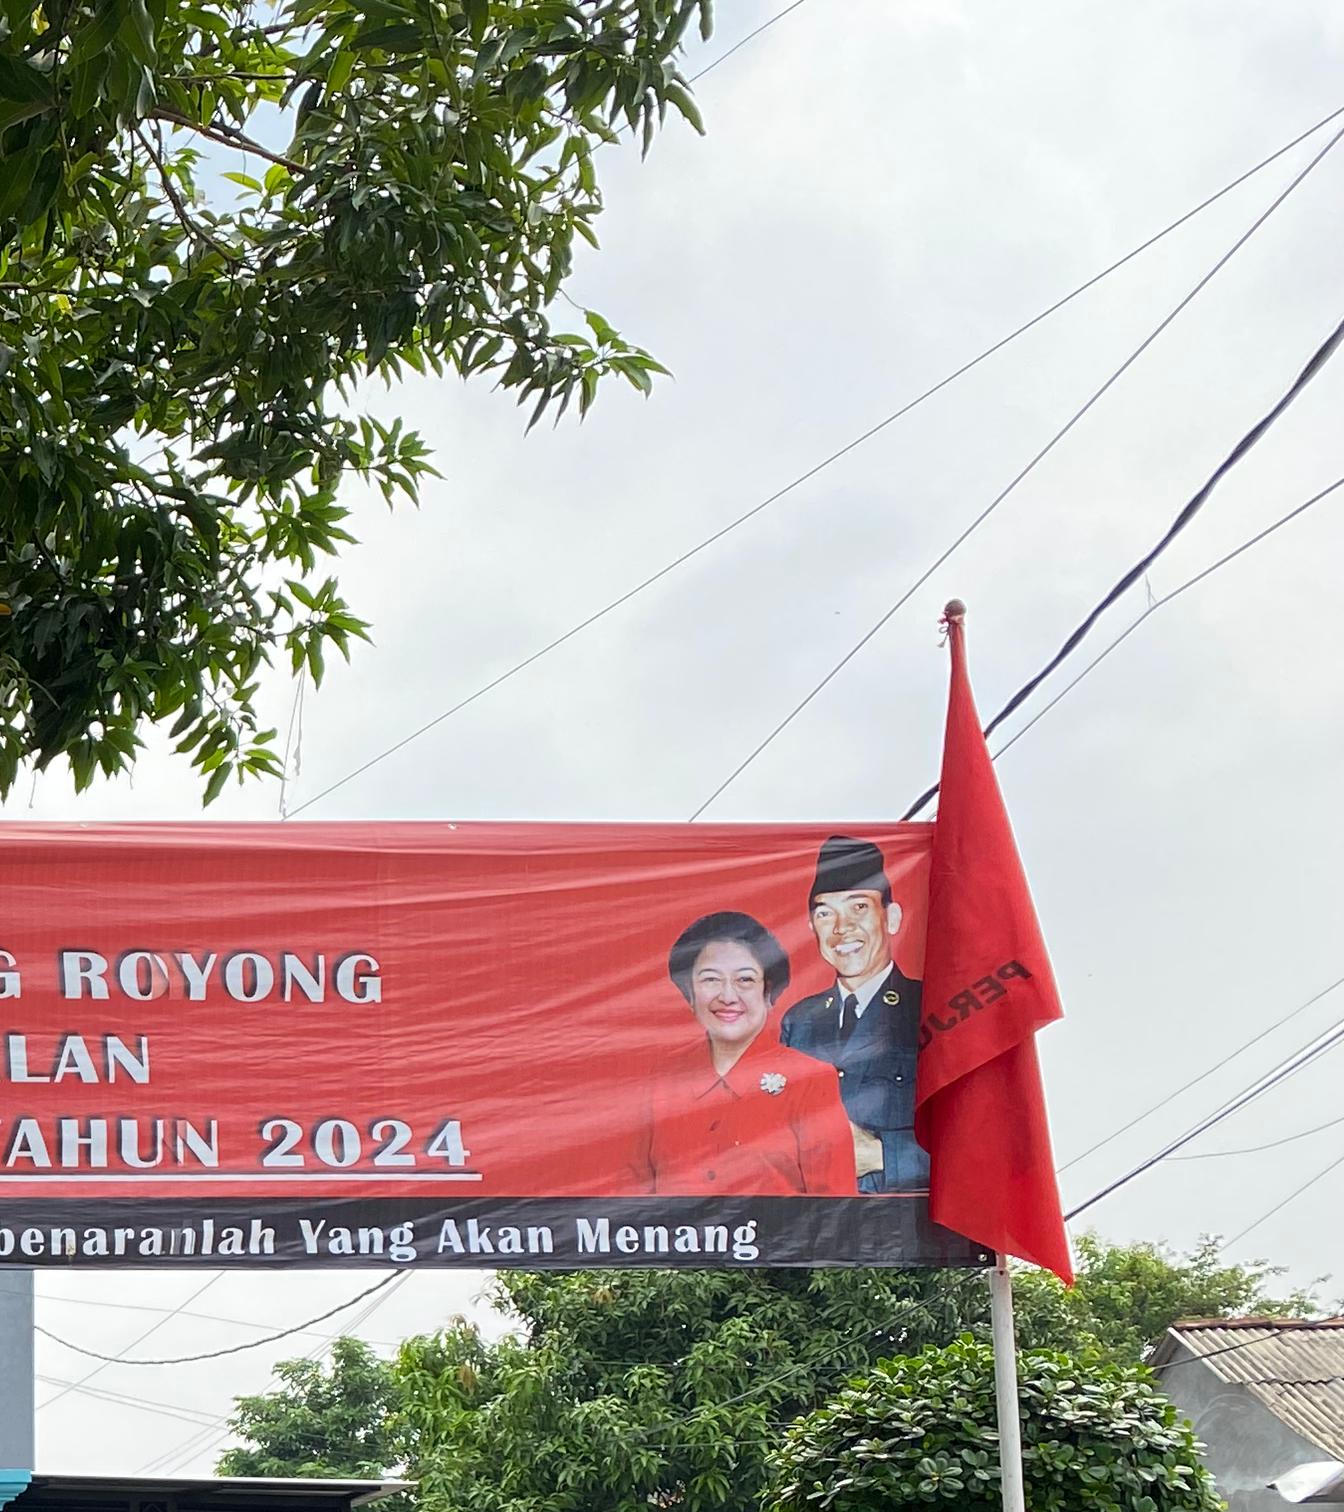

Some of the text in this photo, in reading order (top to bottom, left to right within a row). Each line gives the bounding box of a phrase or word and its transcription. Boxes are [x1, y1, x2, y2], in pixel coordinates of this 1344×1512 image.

[62, 950, 383, 1003] ROYONG
[261, 1119, 470, 1167] 2024
[299, 1218, 416, 1261] Yang
[437, 1217, 554, 1255] Akan
[576, 1217, 760, 1260] Menang
